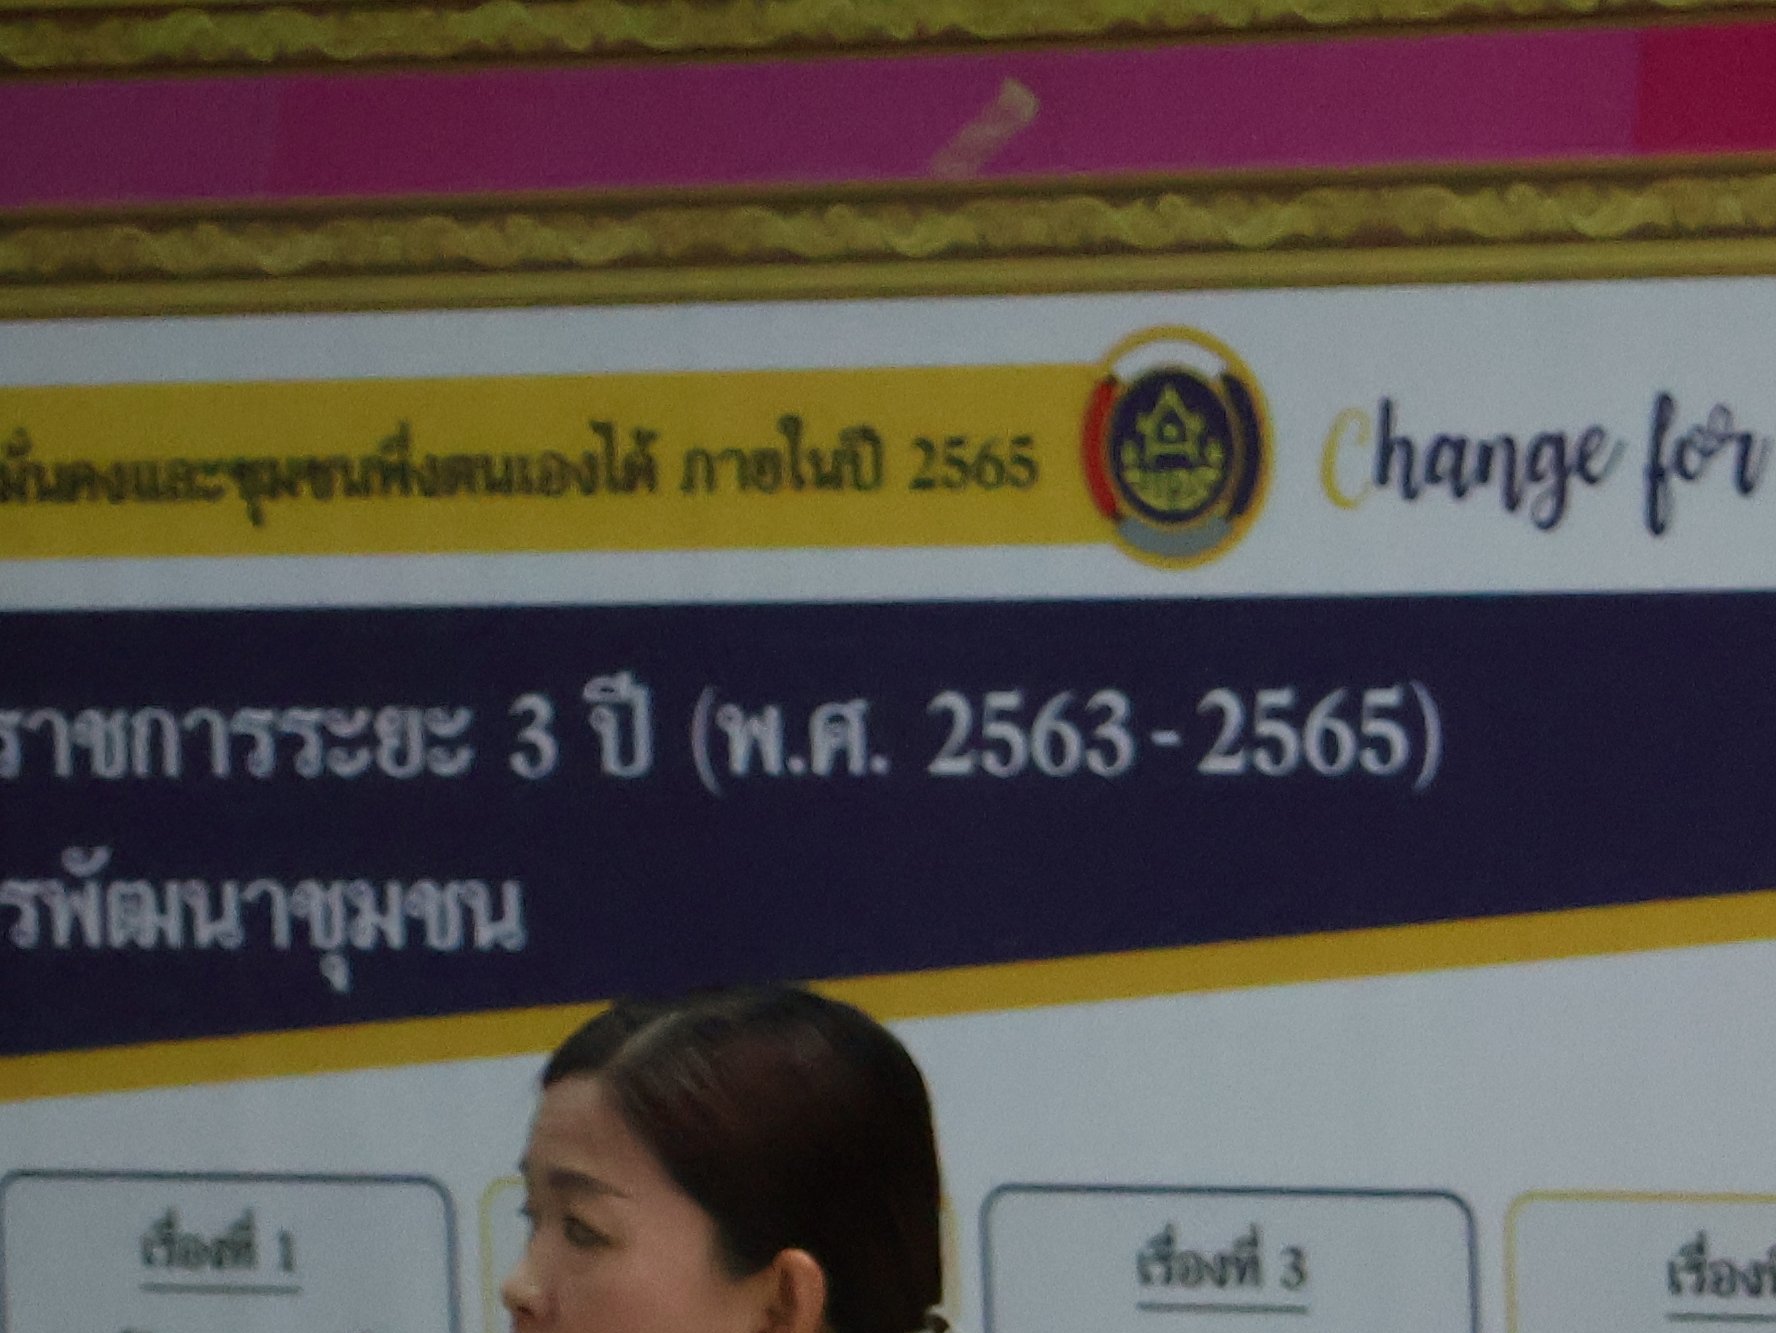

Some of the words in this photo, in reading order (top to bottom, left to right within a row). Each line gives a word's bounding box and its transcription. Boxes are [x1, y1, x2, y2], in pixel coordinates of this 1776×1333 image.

[680, 414, 883, 495] ภายในปี
[909, 434, 1040, 492] 2565
[1320, 396, 1625, 532] Change
[1645, 391, 1770, 537] for
[0, 704, 474, 780] ราชการระยะ
[509, 692, 560, 779] 3
[583, 669, 653, 779] ปี
[691, 685, 890, 798] (พ.ศ.
[0, 845, 527, 994] รพัฒนาชุมชน
[277, 1227, 296, 1274] 1
[1136, 1222, 1265, 1289] เรื่องที่
[1280, 1246, 1306, 1291] 3
